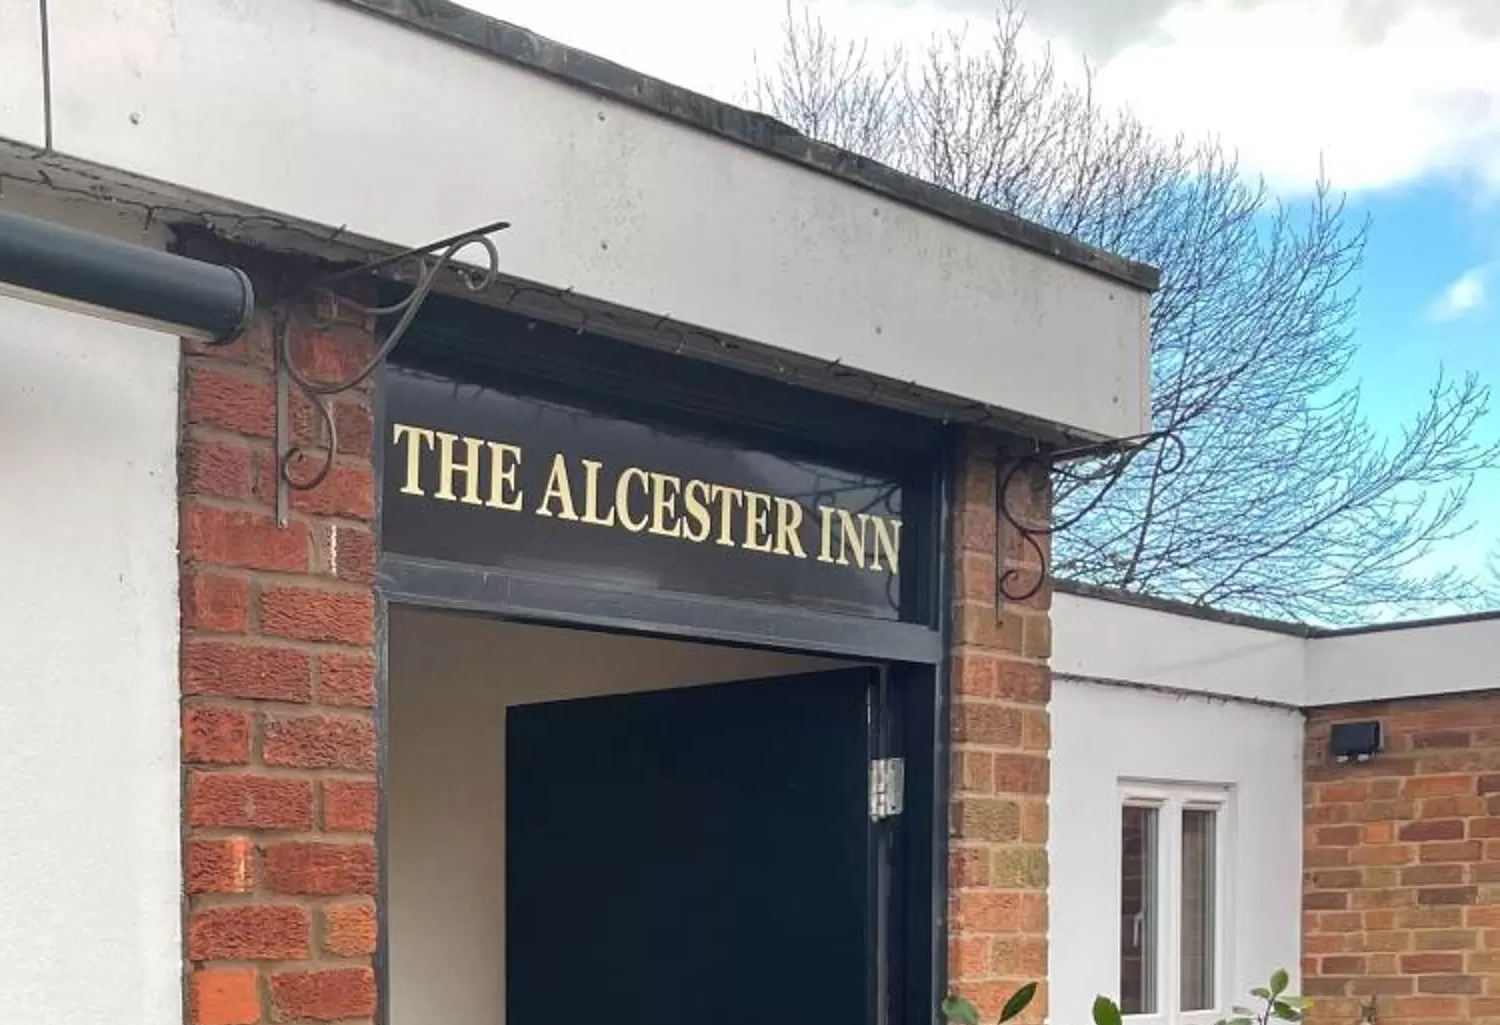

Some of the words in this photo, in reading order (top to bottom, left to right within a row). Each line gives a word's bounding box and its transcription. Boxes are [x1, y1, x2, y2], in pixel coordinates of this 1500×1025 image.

[392, 423, 523, 513] THE
[535, 453, 807, 559] ALCESTER
[816, 506, 902, 574] INN
